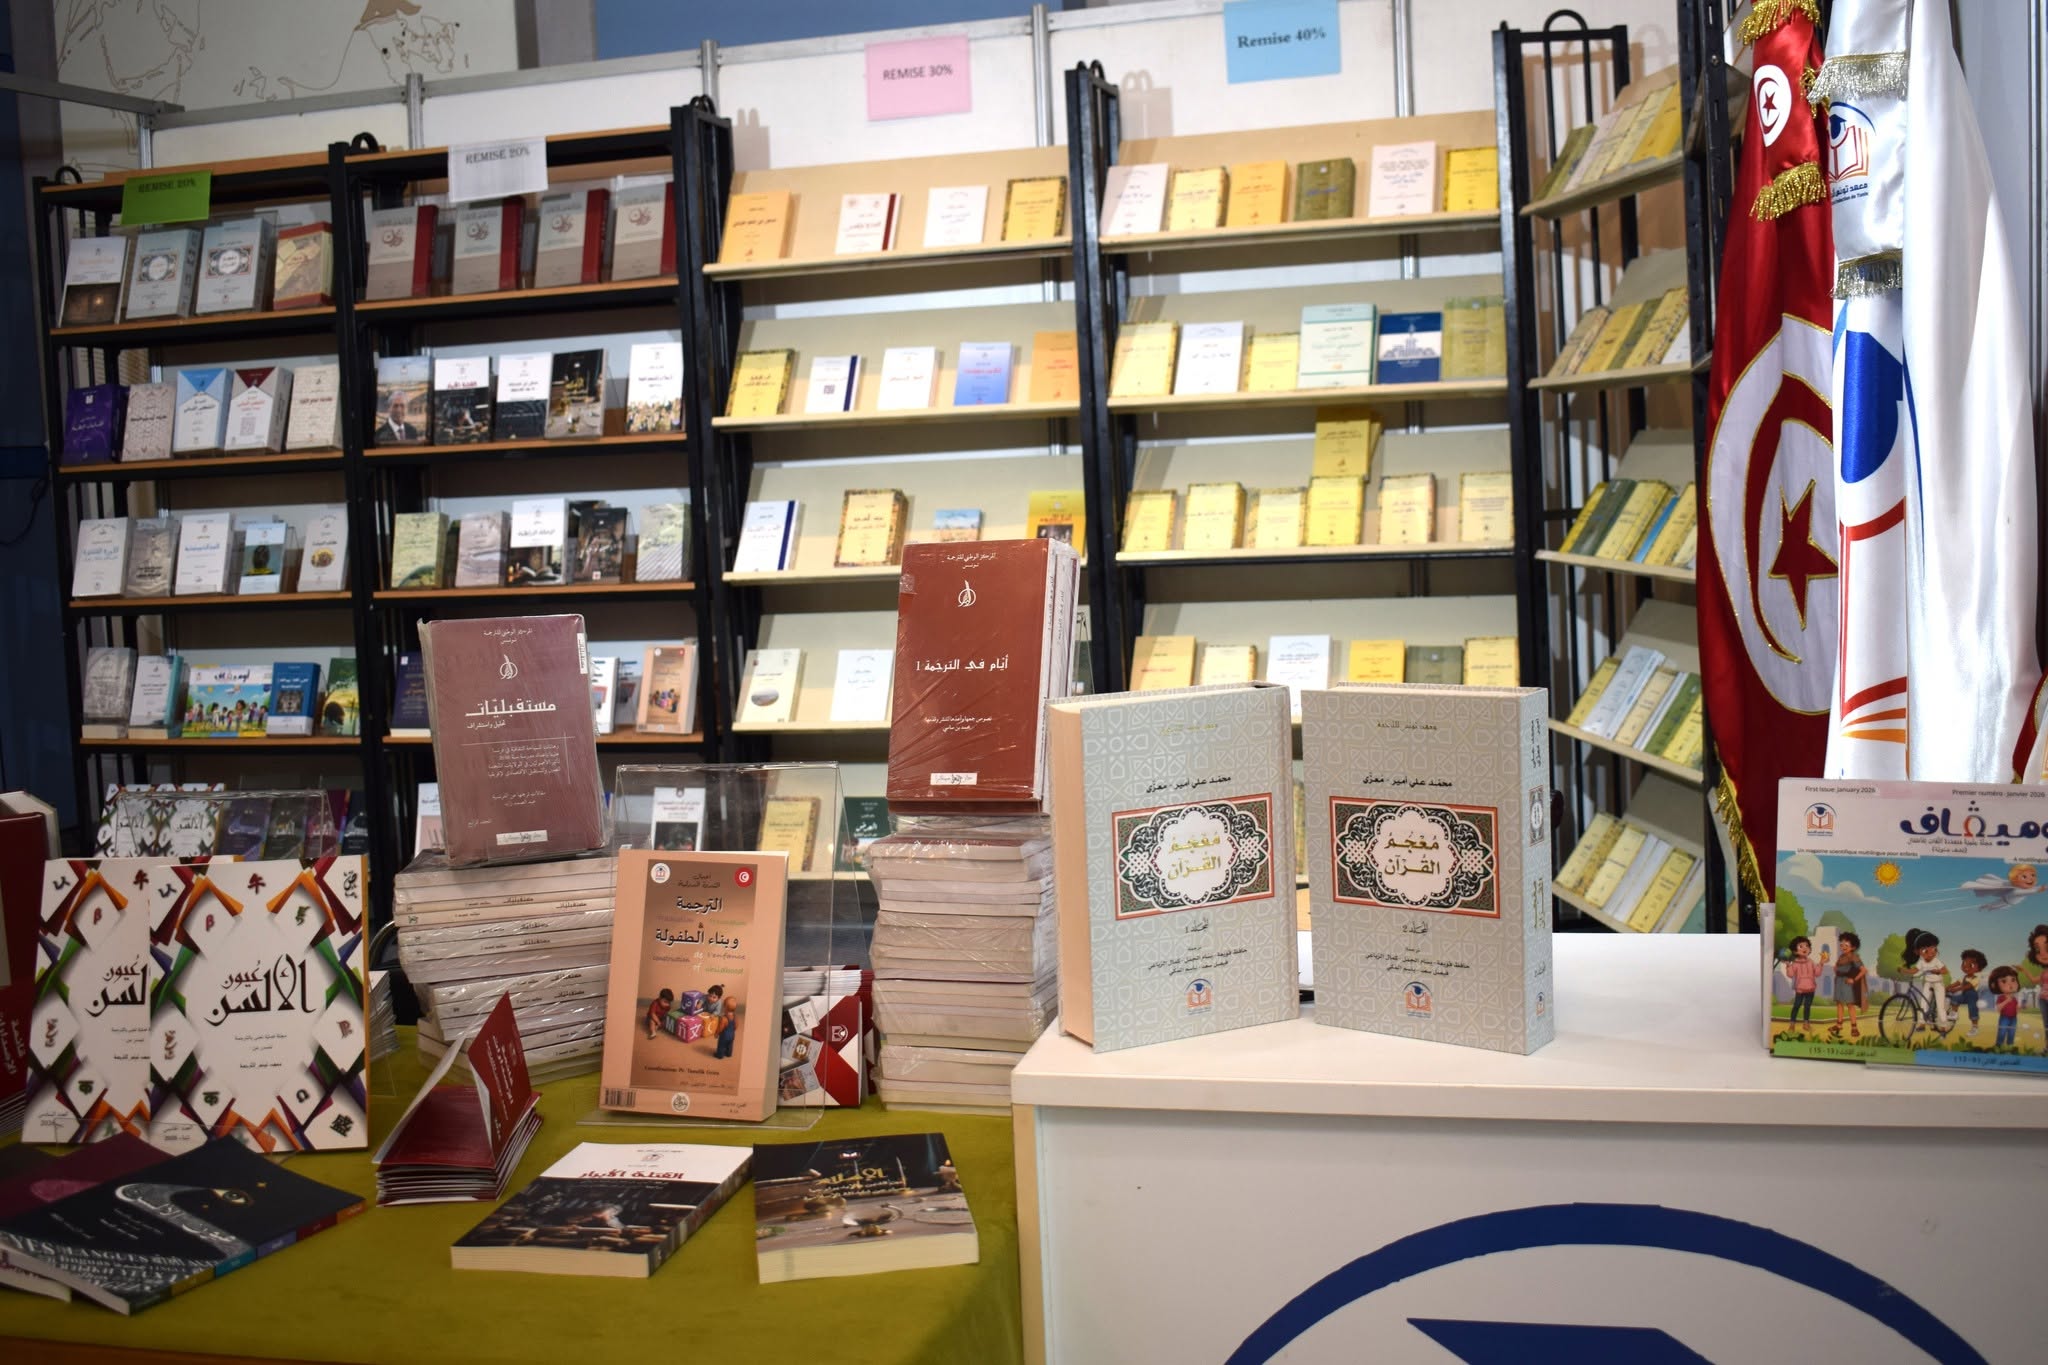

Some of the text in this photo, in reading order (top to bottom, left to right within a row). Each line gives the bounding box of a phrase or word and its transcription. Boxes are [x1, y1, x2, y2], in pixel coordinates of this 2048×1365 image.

[1237, 26, 1327, 49] Remise 40%
[883, 65, 953, 81] REMISE 30%
[465, 145, 530, 165] REMISE 20%
[138, 181, 176, 194] REMISE
[1850, 183, 1868, 192] معهد
[964, 659, 985, 671] في
[1174, 778, 1190, 791] أمير
[1192, 778, 1207, 788] علي
[1391, 776, 1408, 786] أمير
[1410, 778, 1425, 788] علي
[248, 873, 266, 895] 午
[676, 896, 722, 914] الترجمة
[206, 914, 215, 932] β
[655, 928, 705, 946] الطفولة
[204, 953, 317, 1026] الألسن
[296, 1089, 310, 1103] Ω
